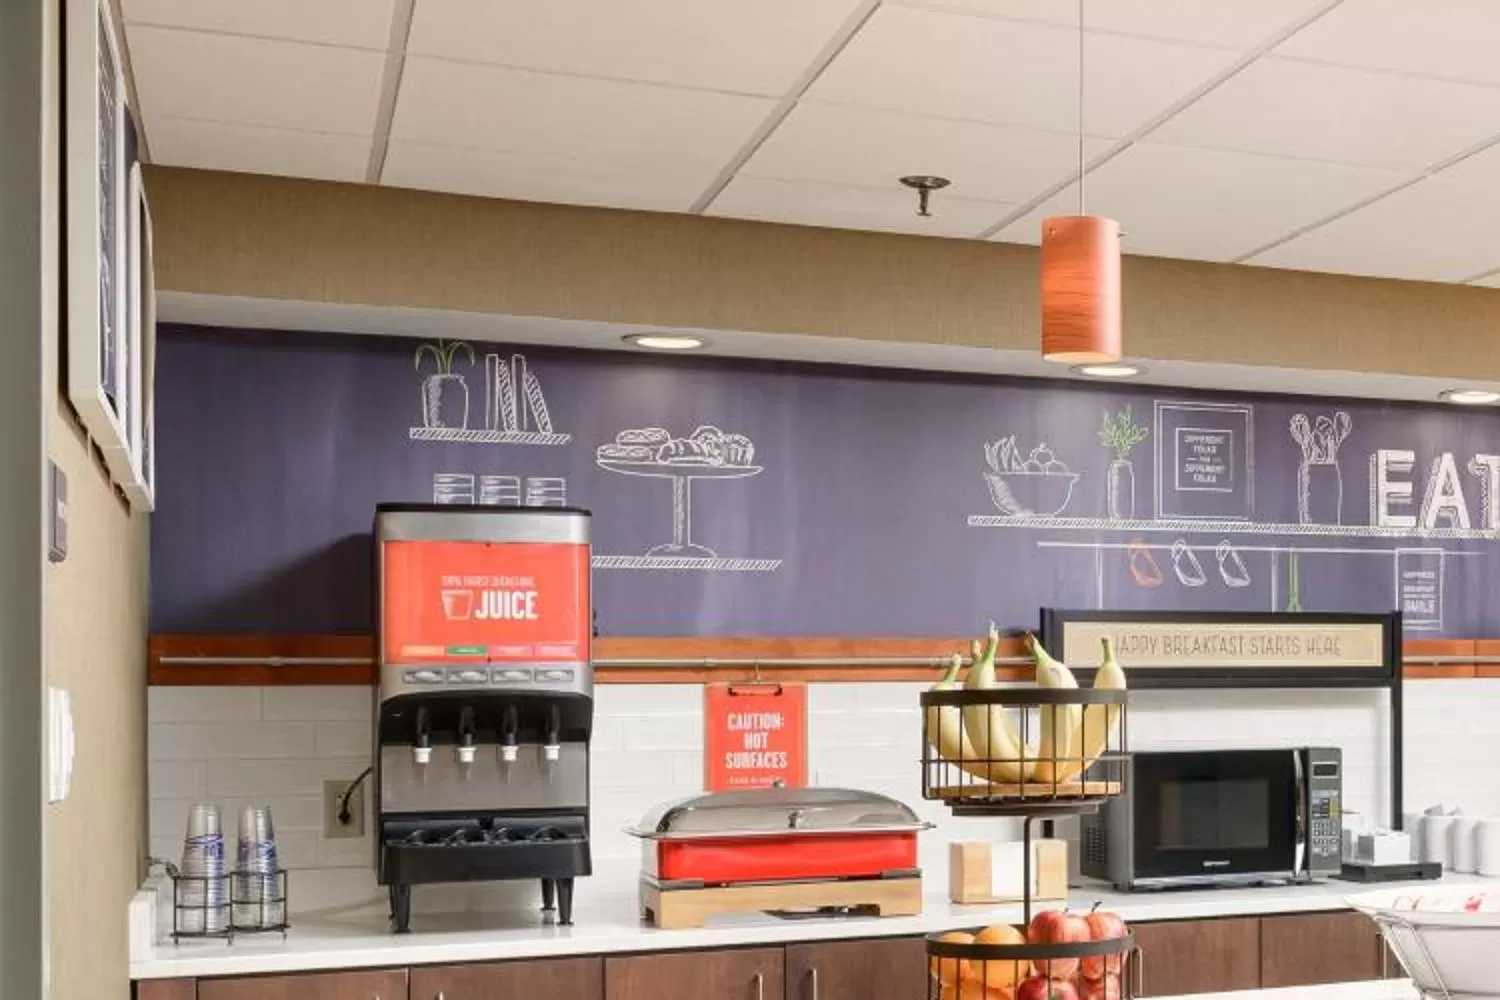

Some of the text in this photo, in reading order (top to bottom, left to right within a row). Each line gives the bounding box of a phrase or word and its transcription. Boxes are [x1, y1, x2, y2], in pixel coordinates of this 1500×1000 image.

[476, 591, 538, 619] JUICE
[1115, 633, 1342, 657] APPY BREAKFAST STARTS HERE
[727, 712, 785, 731] CAUTION:
[744, 732, 768, 749] HOT
[725, 752, 788, 769] SURFACES
